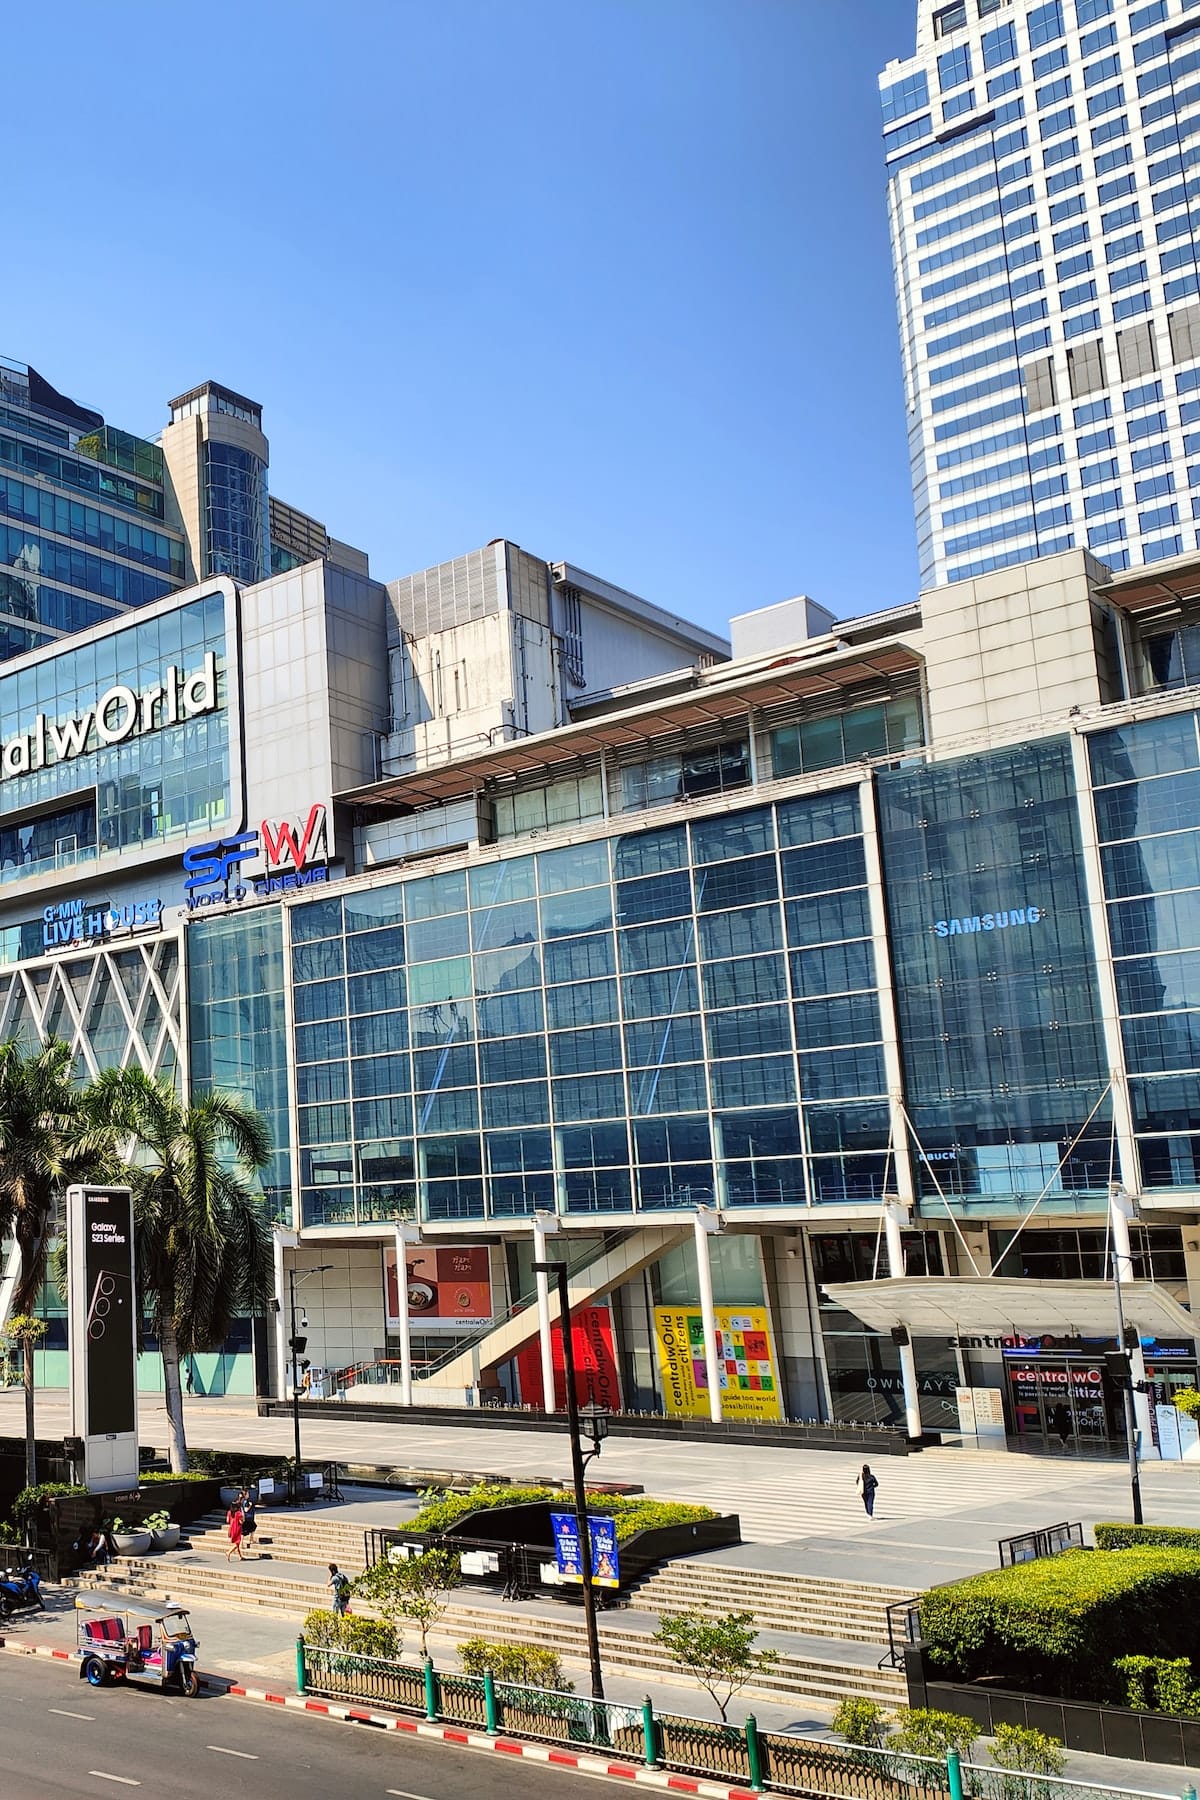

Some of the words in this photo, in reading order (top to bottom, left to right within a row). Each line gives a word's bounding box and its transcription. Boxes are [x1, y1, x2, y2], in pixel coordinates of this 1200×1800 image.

[185, 885, 247, 910] WORLD
[253, 866, 328, 897] CINEMA
[43, 916, 84, 946] LIVE
[935, 906, 1040, 937] SAMSUNG
[91, 1222, 117, 1234] Galaxy
[91, 1233, 103, 1243] S23
[104, 1233, 125, 1243] Series
[455, 1318, 492, 1326] centralwOr
[675, 1315, 689, 1364] citizens
[660, 1315, 683, 1407] centralwOrld
[867, 1377, 957, 1392] OWNAYS
